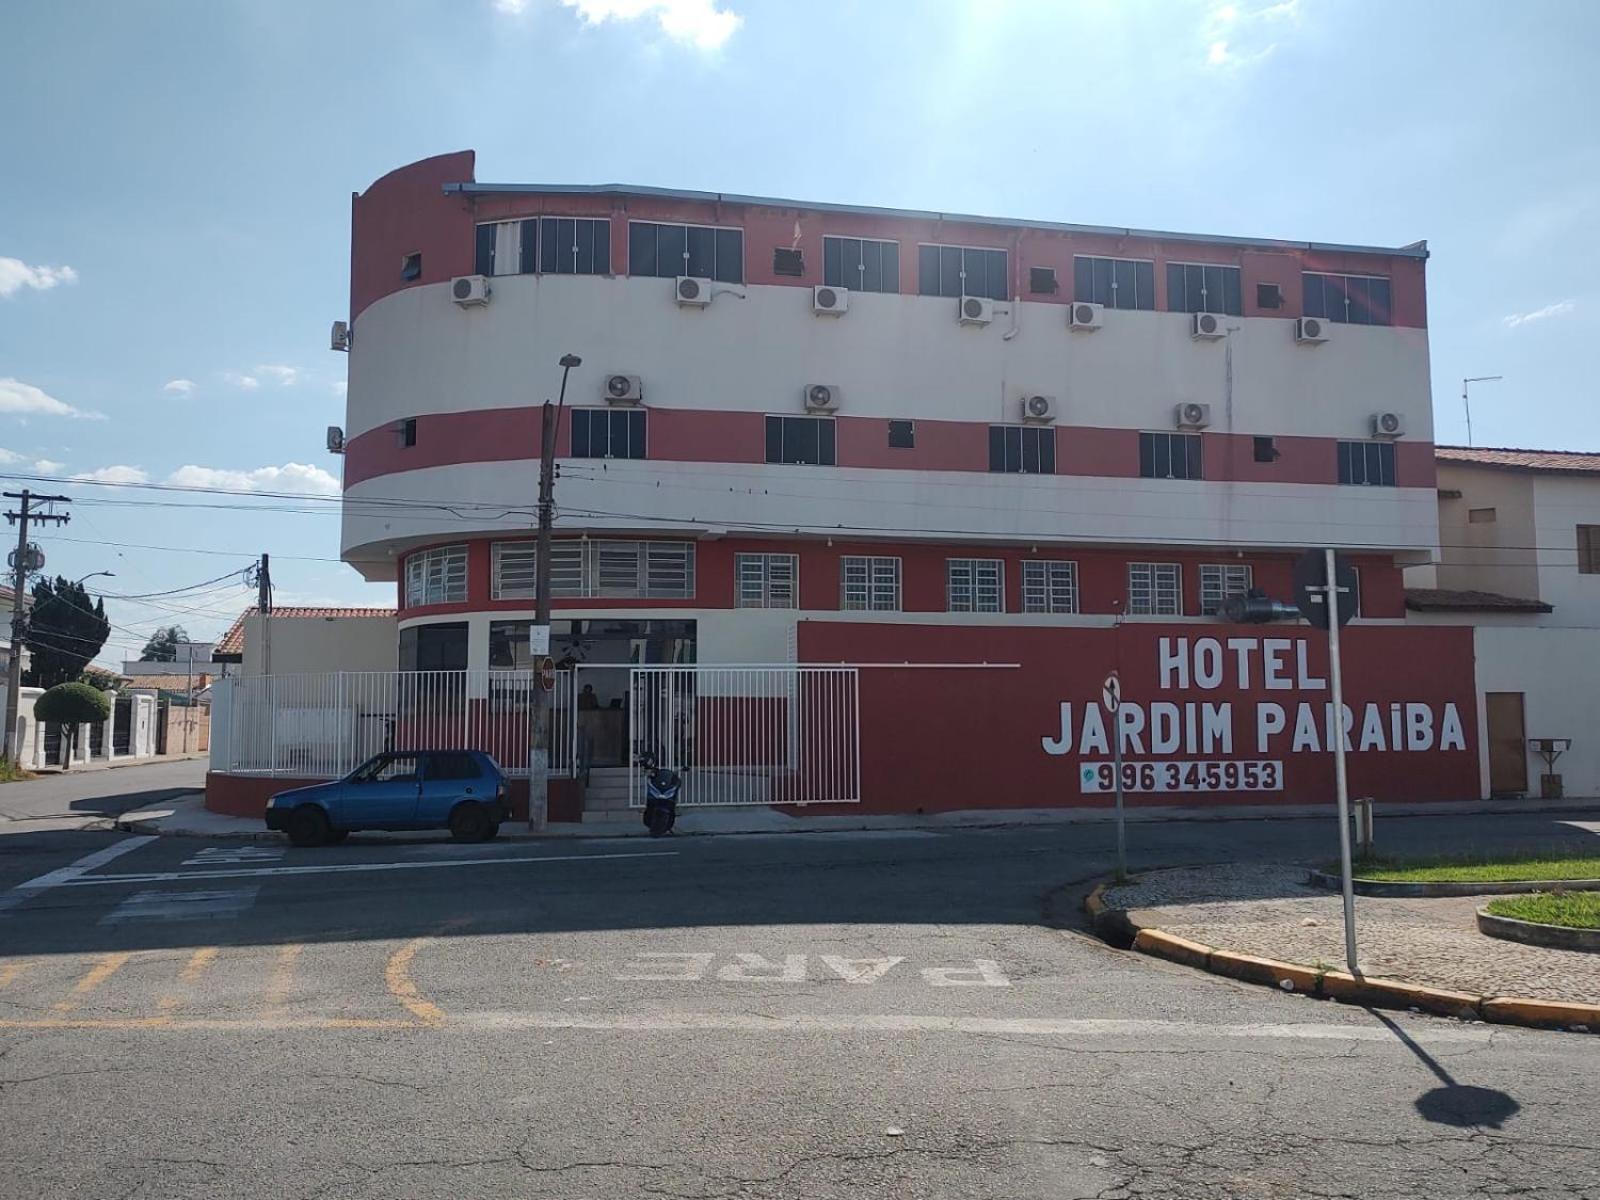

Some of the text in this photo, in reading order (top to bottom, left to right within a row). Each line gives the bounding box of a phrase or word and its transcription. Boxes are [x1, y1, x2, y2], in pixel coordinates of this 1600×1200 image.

[1159, 637, 1327, 690] HOTEL
[1041, 702, 1233, 755] JARDIM
[610, 953, 1010, 986] PARE
